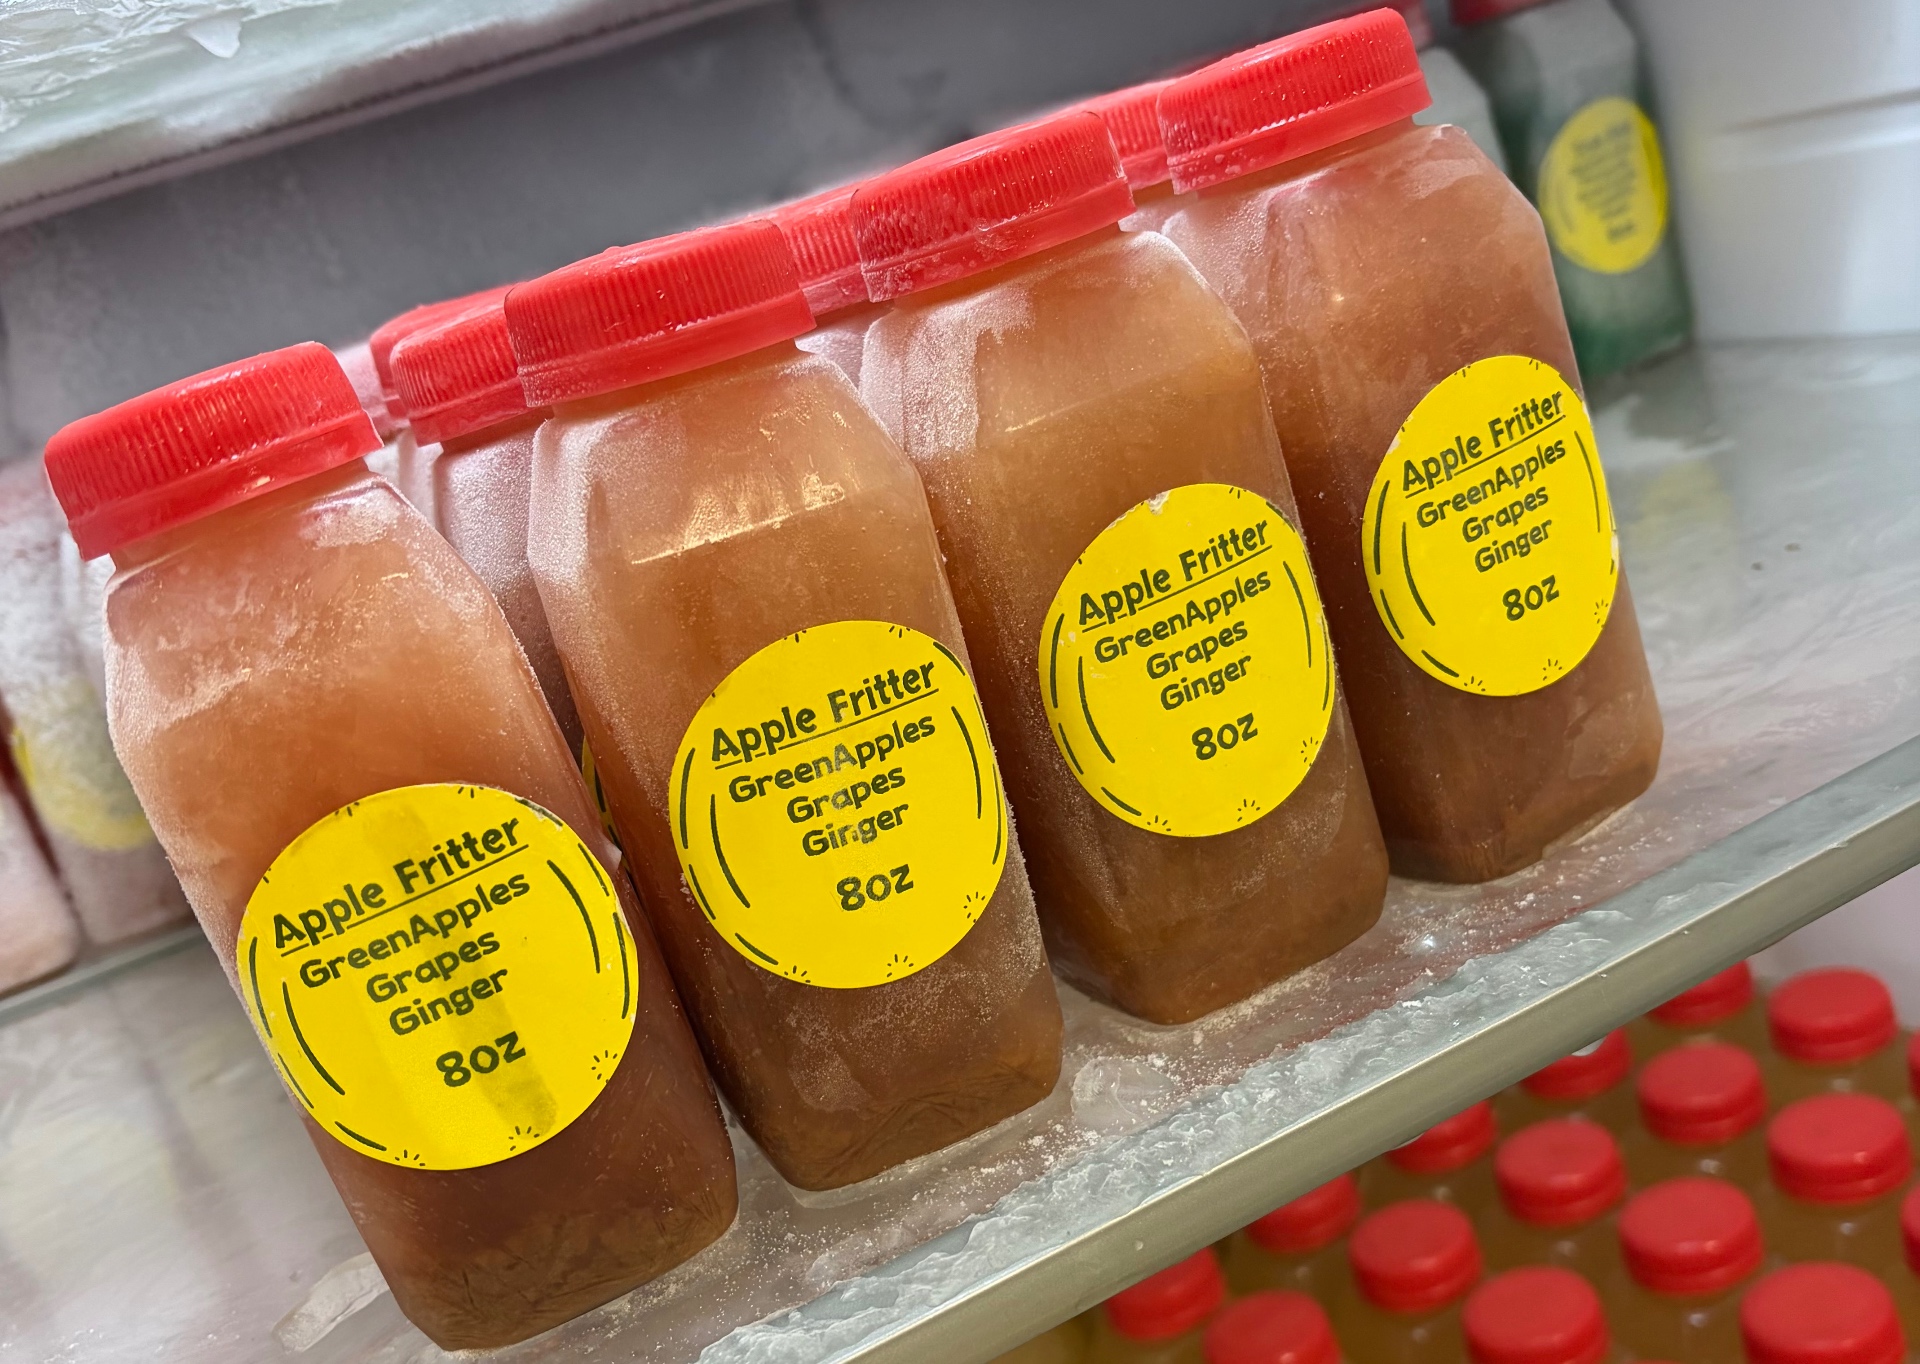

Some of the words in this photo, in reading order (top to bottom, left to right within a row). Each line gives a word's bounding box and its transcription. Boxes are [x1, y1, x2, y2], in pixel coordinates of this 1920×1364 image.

[1402, 436, 1481, 491] Apple
[1488, 391, 1563, 447] Fritter
[1417, 439, 1566, 528] GreenApples
[1462, 486, 1549, 543] Grapes
[1079, 569, 1170, 626] Apple
[1179, 520, 1268, 581] Fritter
[1474, 519, 1552, 573] Ginger
[1095, 571, 1271, 663] GreenApples
[1502, 575, 1559, 621] 8oz
[1147, 621, 1248, 679] Grapes
[711, 707, 816, 762] Apple
[827, 661, 935, 722] Fritter
[1161, 655, 1251, 710] Ginger
[729, 715, 935, 802] GreenApples
[1191, 713, 1258, 760] 8oz
[787, 767, 905, 823] Grapes
[802, 804, 909, 856] Ginger
[273, 883, 387, 948] Apple
[394, 818, 519, 895] Fritter
[836, 864, 913, 911] 8oz
[300, 873, 529, 988] GreenApples
[366, 932, 500, 1003] Grapes
[390, 968, 507, 1035] Ginger
[436, 1031, 526, 1087] 8oz
